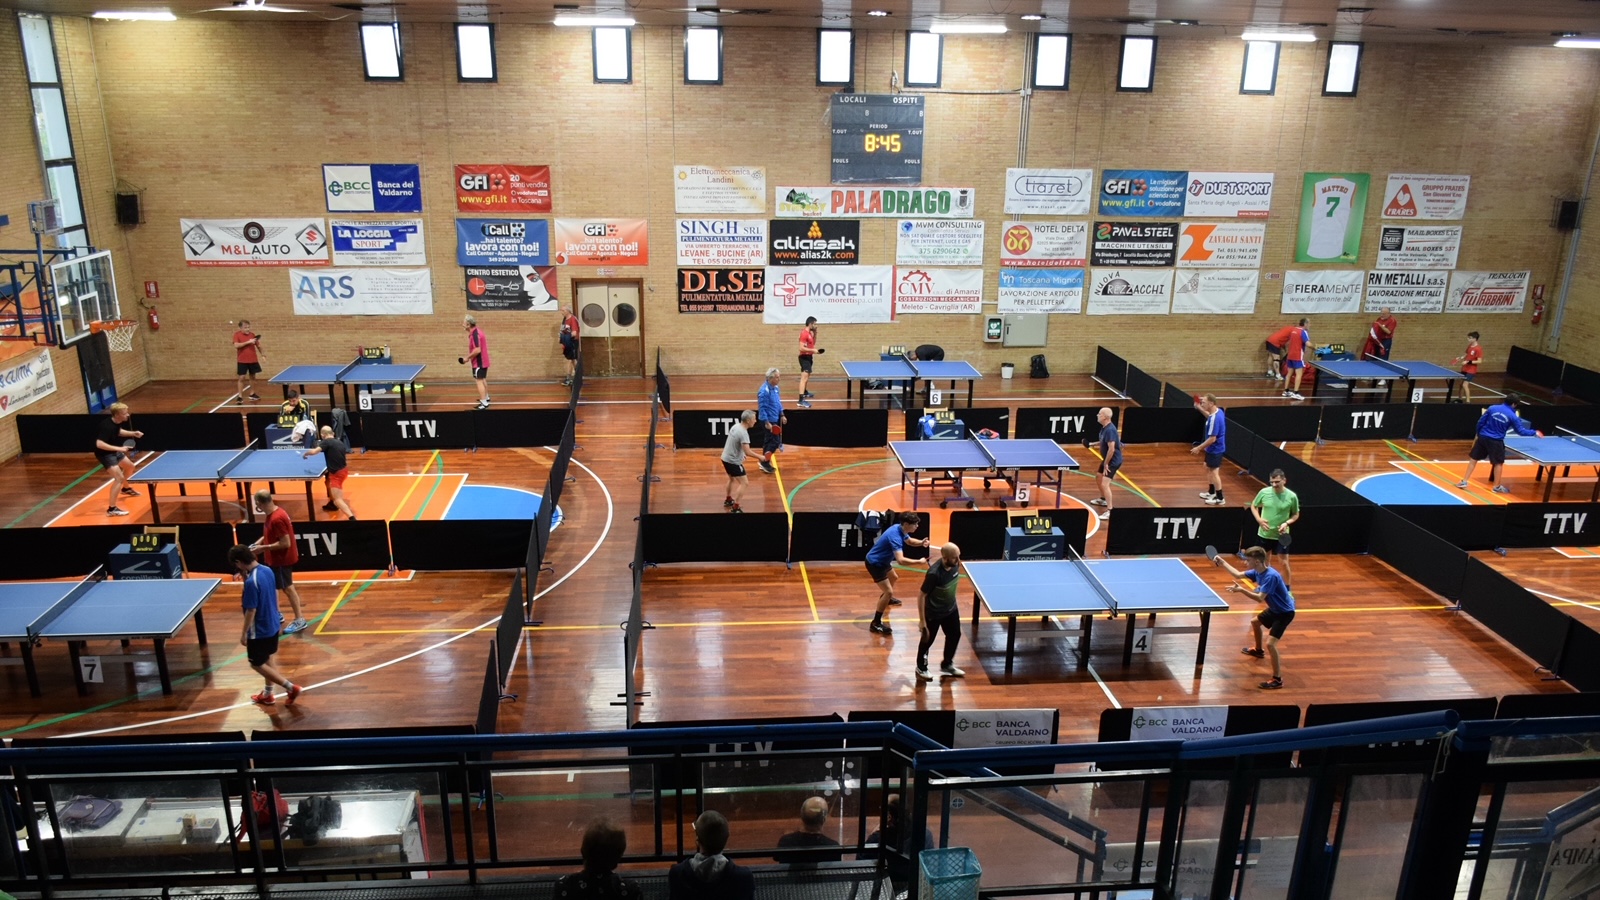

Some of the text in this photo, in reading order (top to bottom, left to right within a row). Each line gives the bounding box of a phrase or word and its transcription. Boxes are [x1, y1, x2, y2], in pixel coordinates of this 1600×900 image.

[865, 134, 901, 152] 8:45
[344, 182, 370, 190] BCC
[460, 175, 488, 190] GFI
[1105, 180, 1130, 194] GFI
[1322, 185, 1349, 194] MATTEO
[460, 195, 507, 205] www.gfi.it
[831, 190, 952, 214] PALADRAGO
[1102, 199, 1145, 208] www.gfi.it
[1326, 197, 1340, 217] 7
[585, 224, 605, 235] GFI
[681, 220, 738, 234] SINGH
[1112, 227, 1174, 237] PAVEL STEEL
[221, 245, 290, 255] M&LAUTO
[520, 242, 539, 251] noi!
[619, 242, 638, 251] noi!
[748, 250, 763, 258] (AR)
[774, 250, 854, 259] www.alias2k.com
[681, 271, 764, 292] DI.SE
[1053, 277, 1081, 285] Mignon
[1094, 271, 1120, 295] NUOVA
[1368, 273, 1383, 285] RN
[1384, 273, 1426, 285] METALLI
[297, 276, 355, 299] ARS
[808, 283, 882, 296] MORETTI
[898, 283, 935, 294] CMV
[1107, 284, 1165, 295] REZZACCHI
[6, 363, 33, 384] CLIMA
[932, 394, 938, 403] 6
[1414, 393, 1419, 401] 3
[361, 398, 369, 409] 9
[1050, 416, 1085, 433] T.T.V.
[1351, 411, 1384, 429] T.T.V.
[398, 420, 439, 439] T.T.V.
[1018, 488, 1027, 499] 5
[1154, 517, 1201, 539] T.T.V.
[1544, 513, 1587, 534] T.T.V.
[1136, 635, 1147, 651] 4
[84, 663, 96, 681] 7
